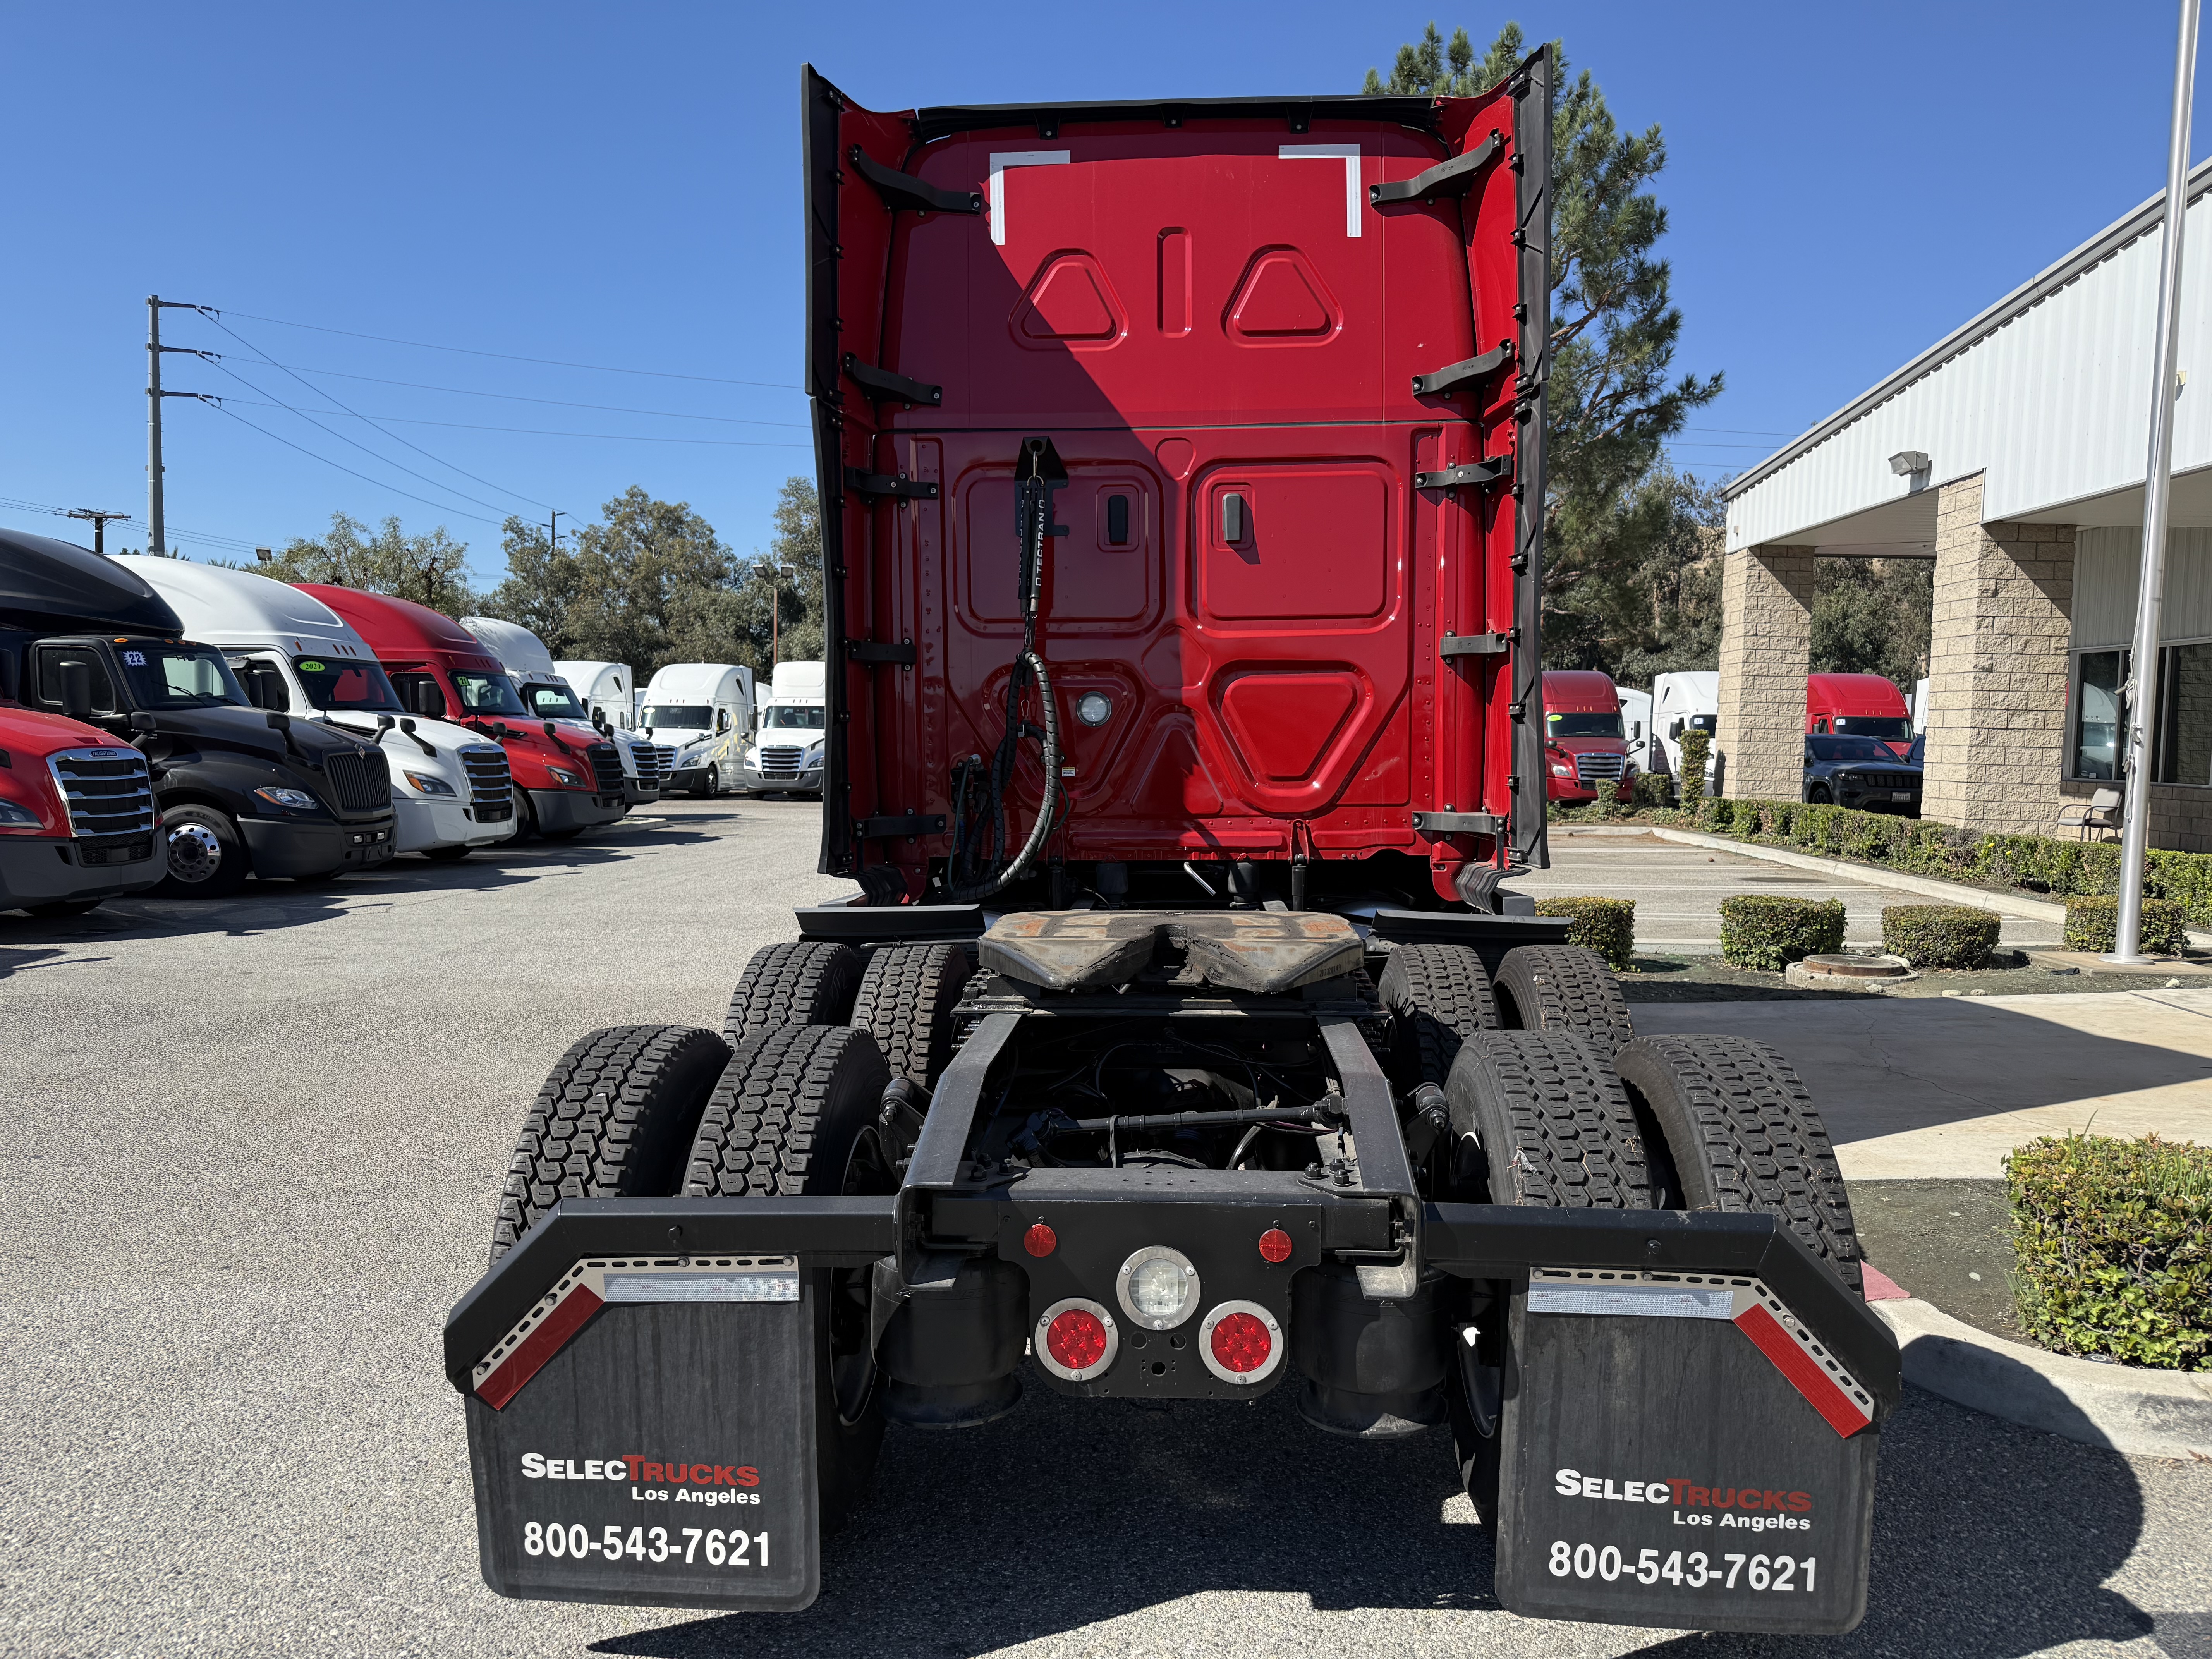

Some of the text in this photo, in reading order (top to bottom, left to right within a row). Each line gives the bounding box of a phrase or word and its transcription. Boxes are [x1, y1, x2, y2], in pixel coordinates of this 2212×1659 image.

[1036, 512, 1044, 574] TECTRAN
[129, 653, 142, 663] 22
[632, 1486, 760, 1506] Los Angeles
[1673, 1510, 1810, 1532] Los Angeles
[524, 1521, 768, 1566] 800-543-7621
[1549, 1540, 1815, 1592] 800-543-7621
